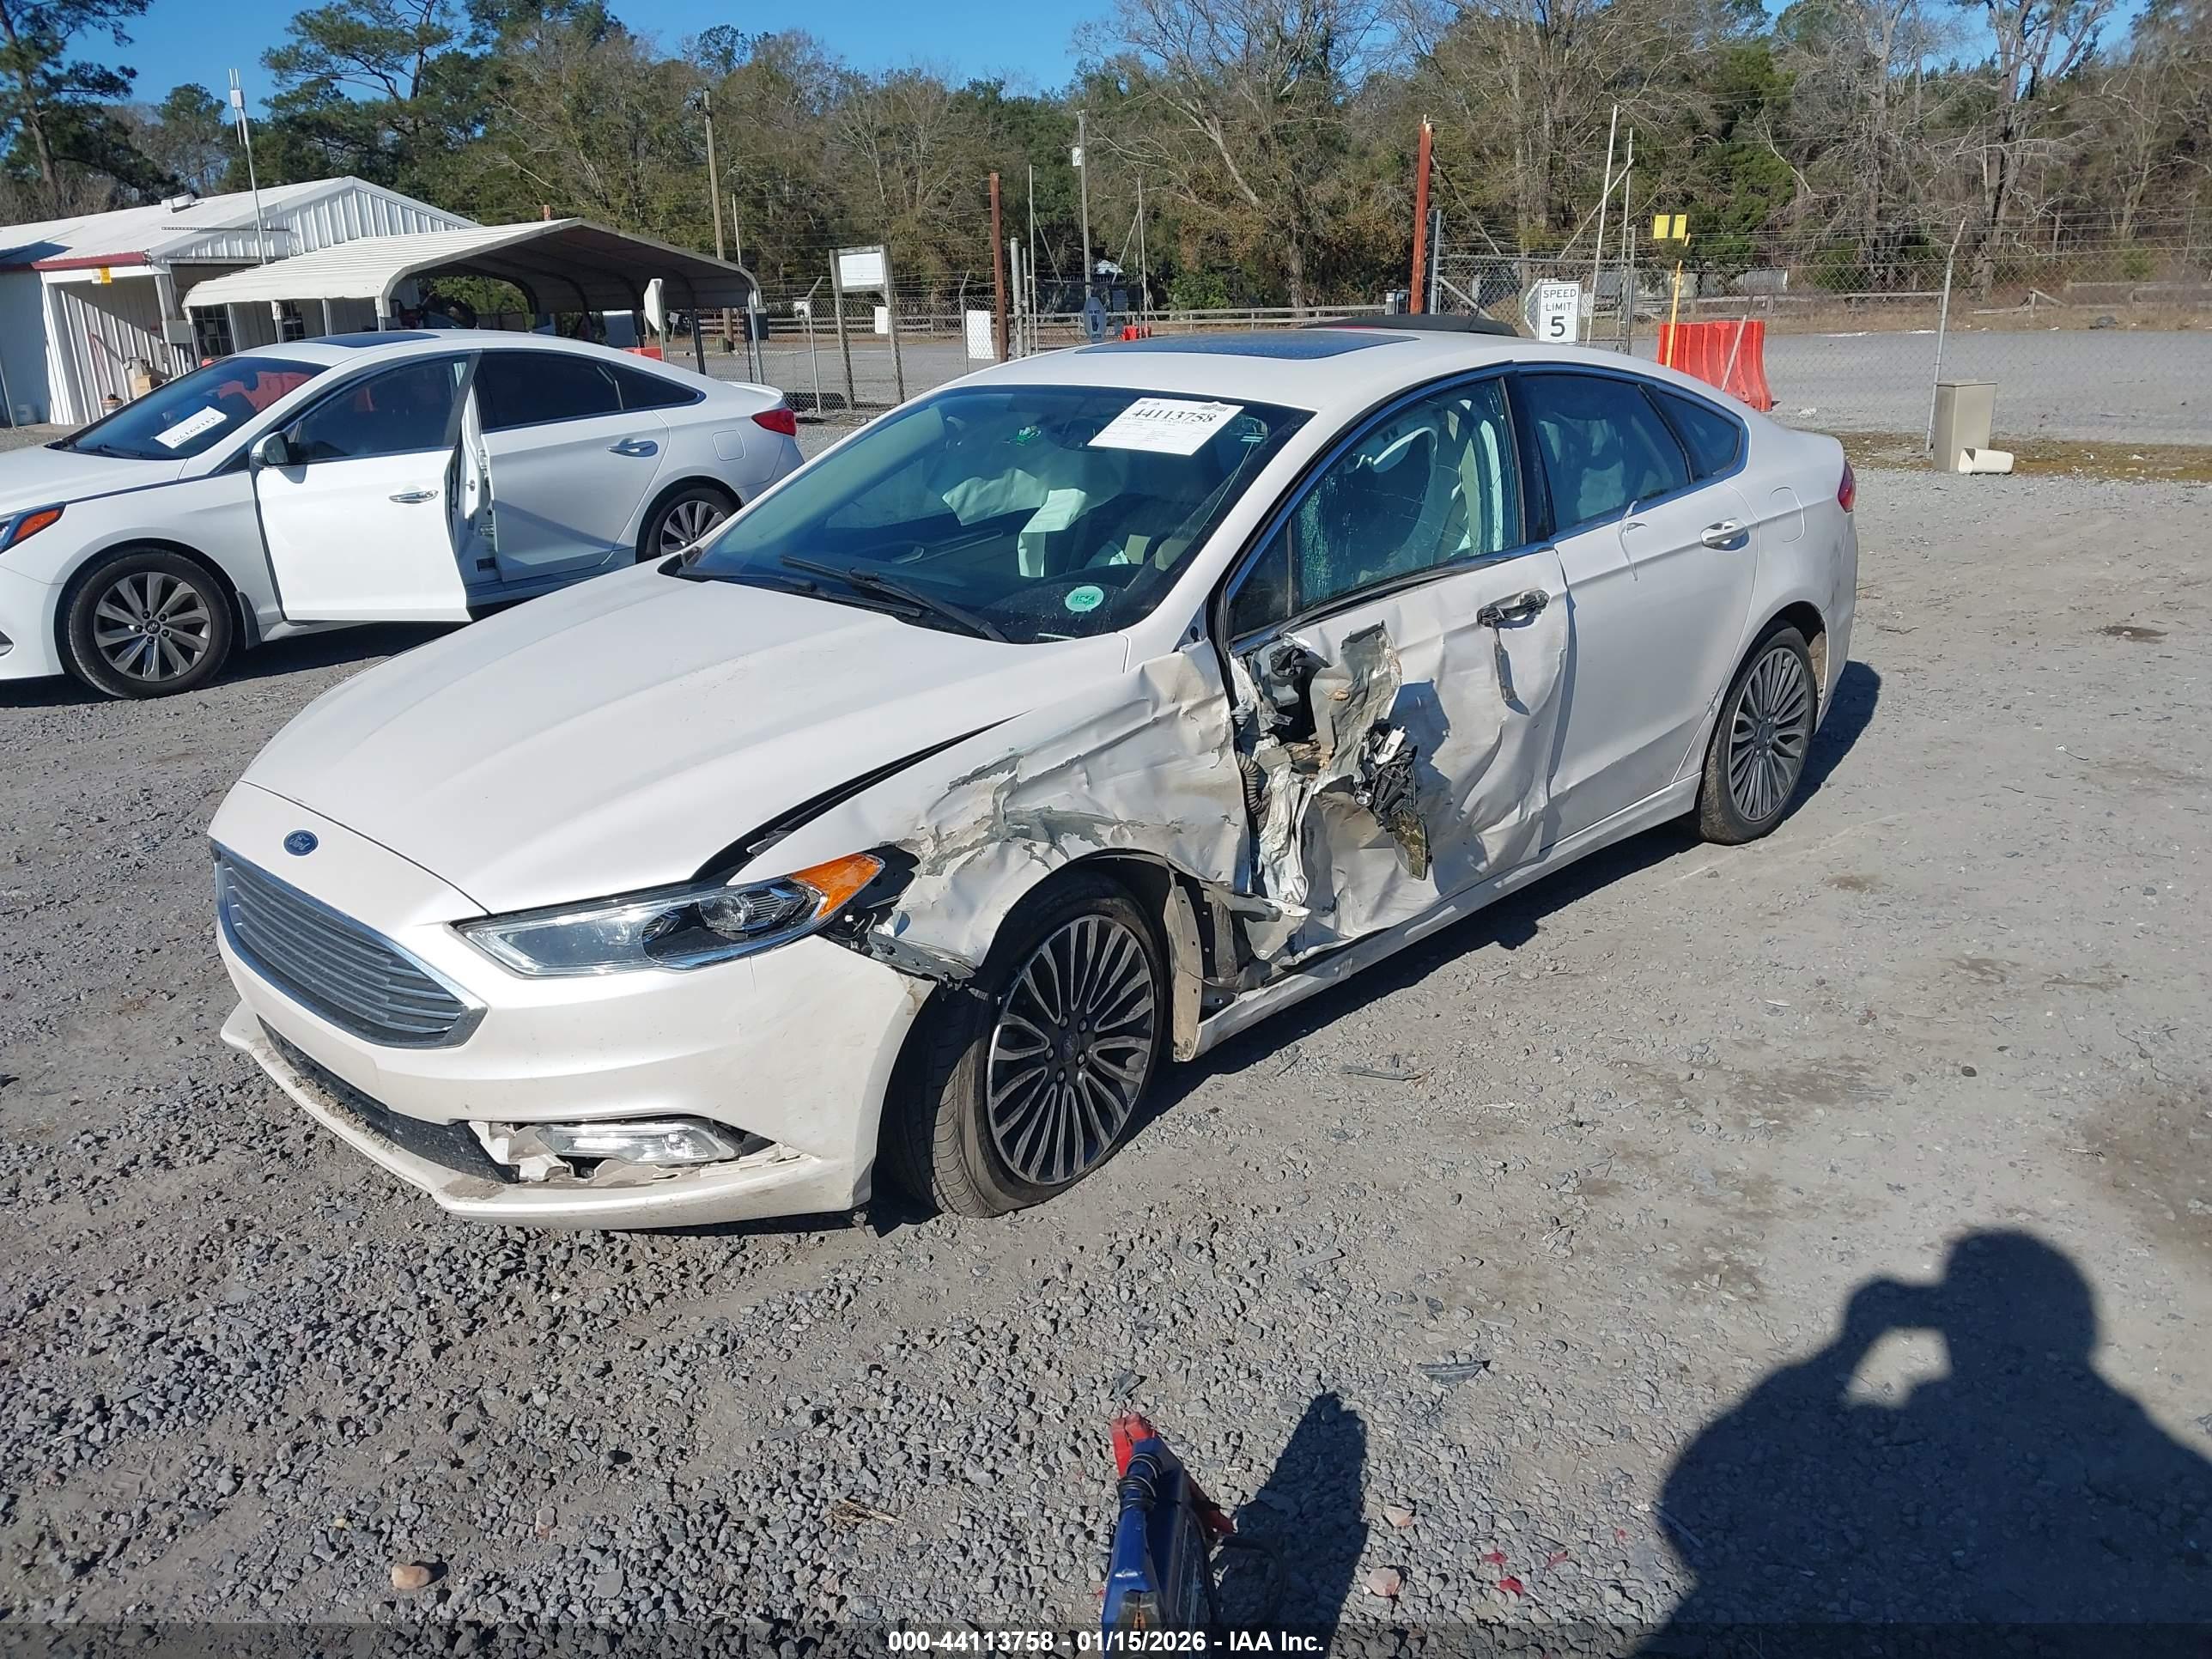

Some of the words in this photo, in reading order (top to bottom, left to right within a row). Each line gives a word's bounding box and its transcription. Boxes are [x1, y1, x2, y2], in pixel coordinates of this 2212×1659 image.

[1543, 289, 1577, 299] SPEED
[1546, 302, 1572, 312] LIMIT
[1550, 315, 1565, 337] 5
[1132, 408, 1217, 423] 44113758
